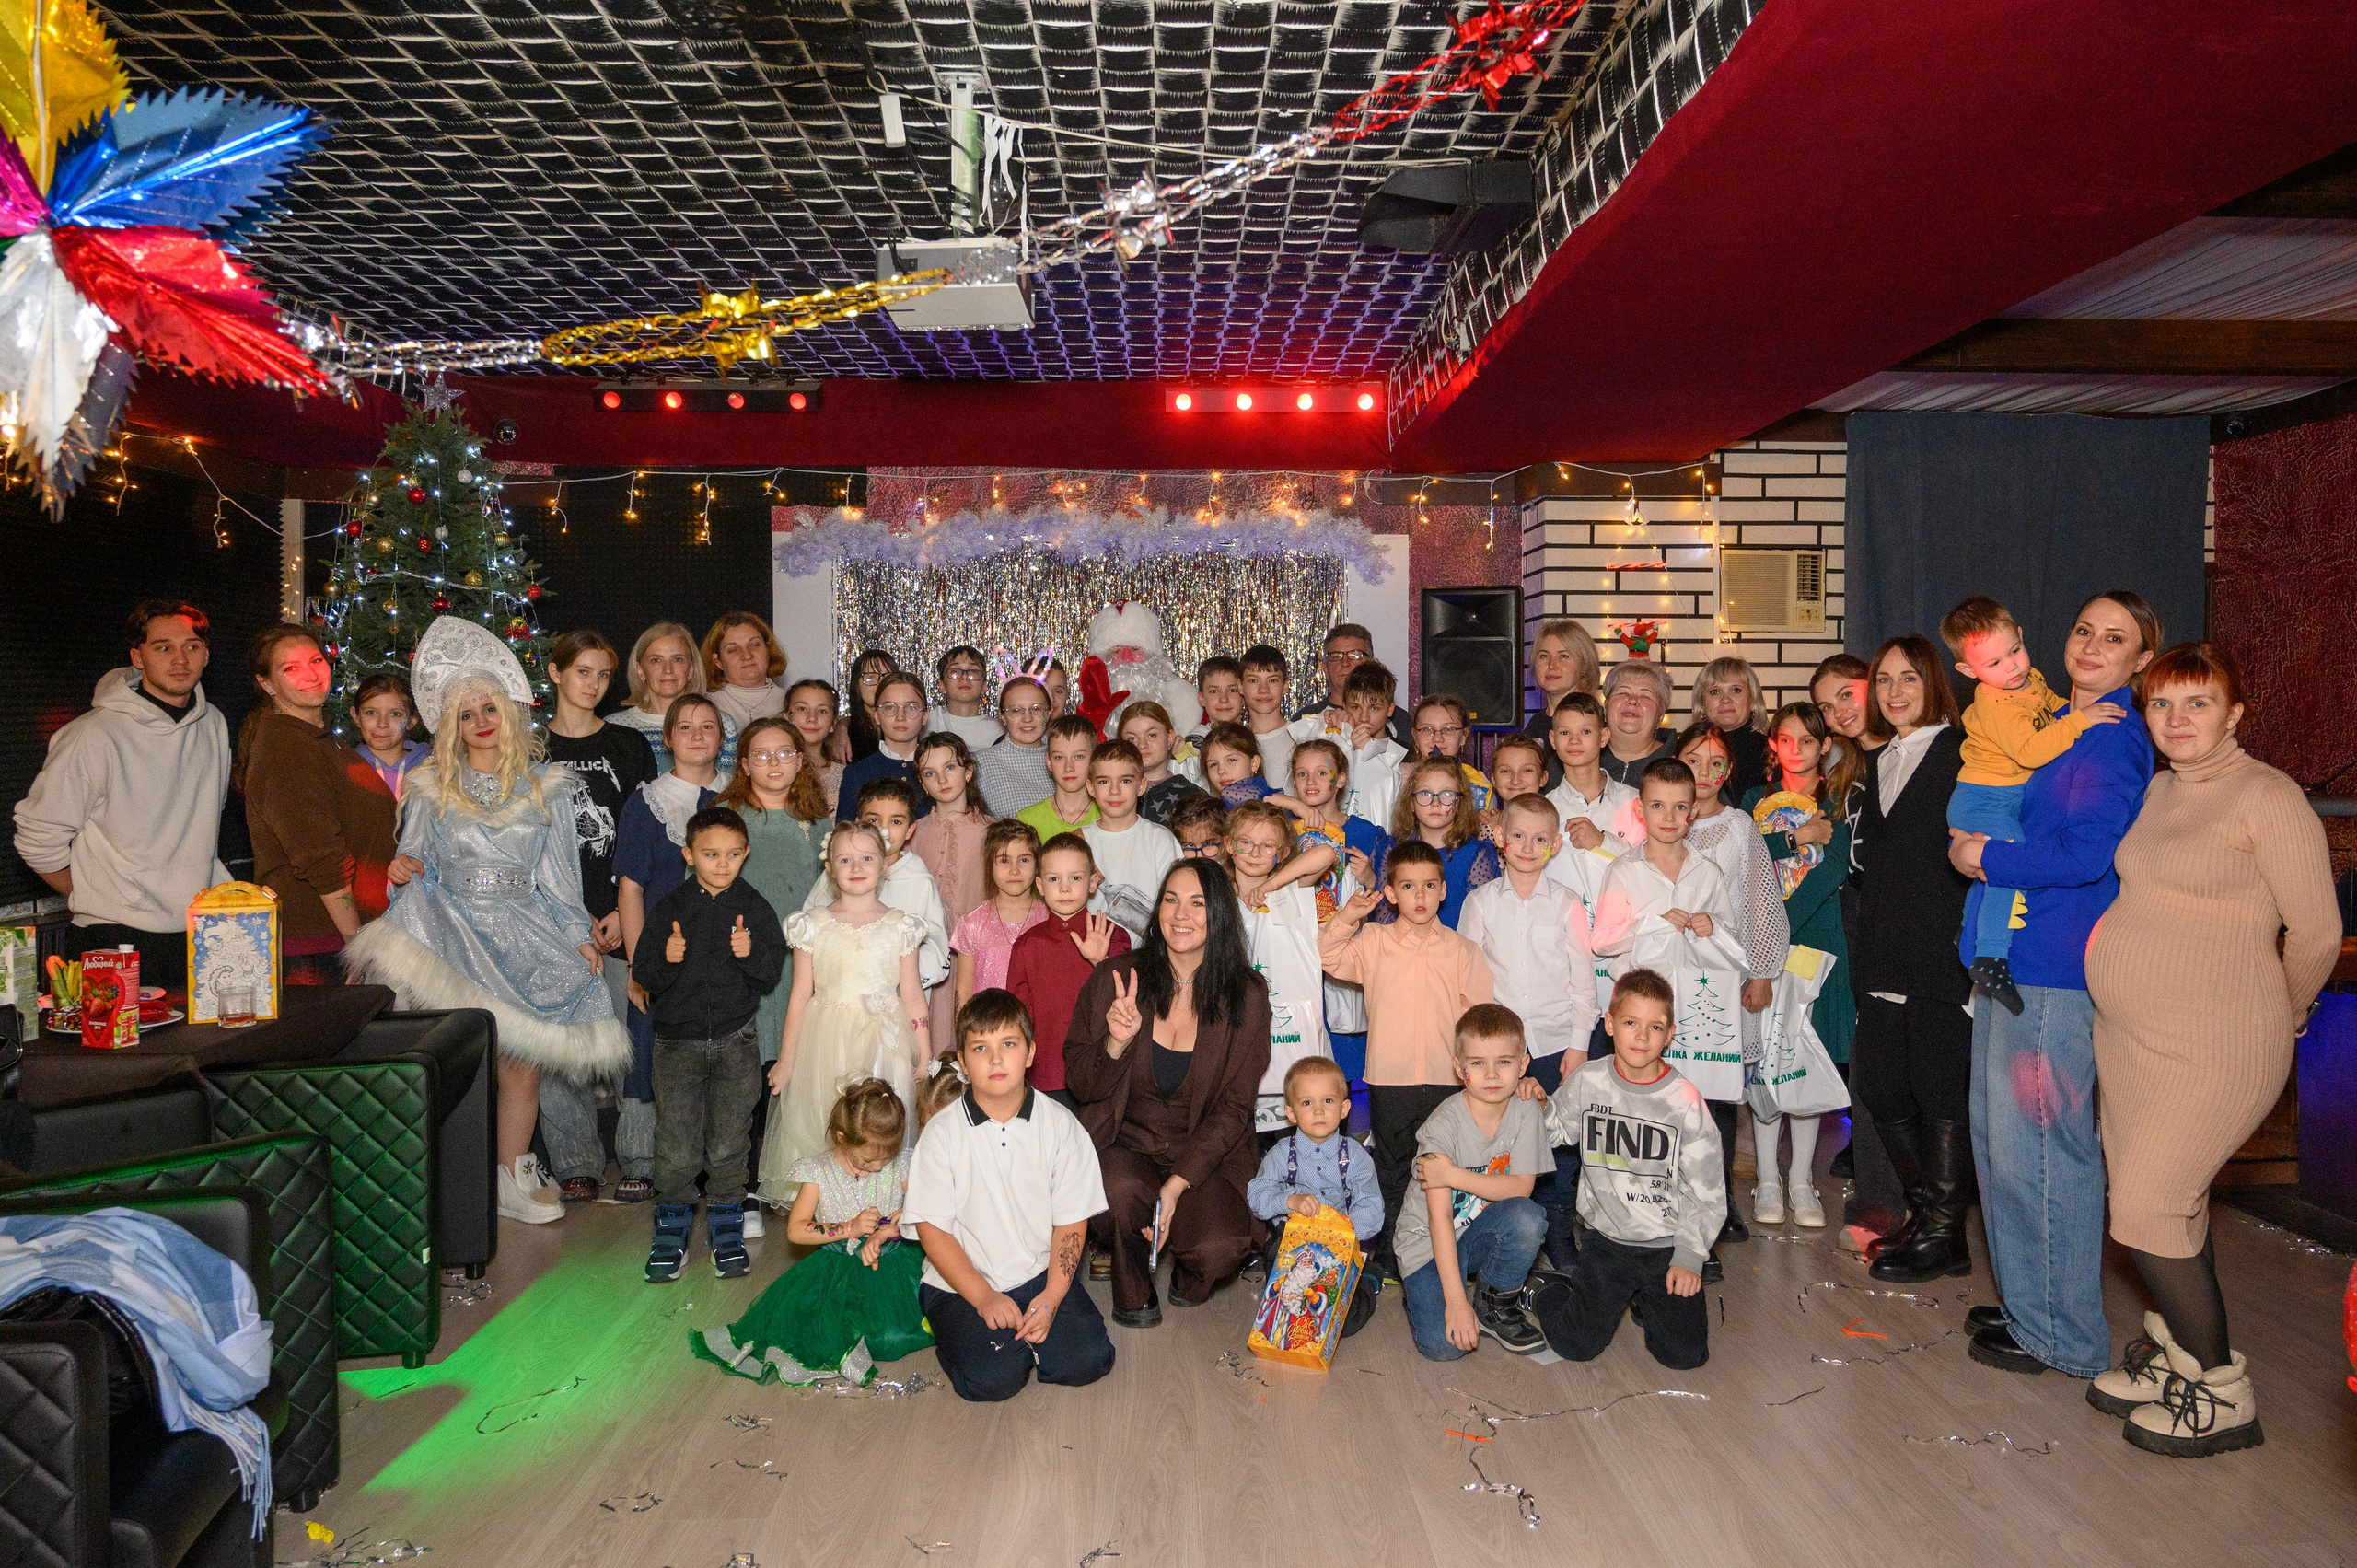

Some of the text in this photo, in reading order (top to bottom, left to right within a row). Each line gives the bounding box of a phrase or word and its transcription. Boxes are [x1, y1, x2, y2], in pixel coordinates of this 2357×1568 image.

[1693, 1050, 1741, 1063] ЖЕЛАНИЙ
[1590, 1103, 1613, 1115] FBDT
[1587, 1115, 1669, 1161] FIND
[1666, 1167, 1674, 1179] N
